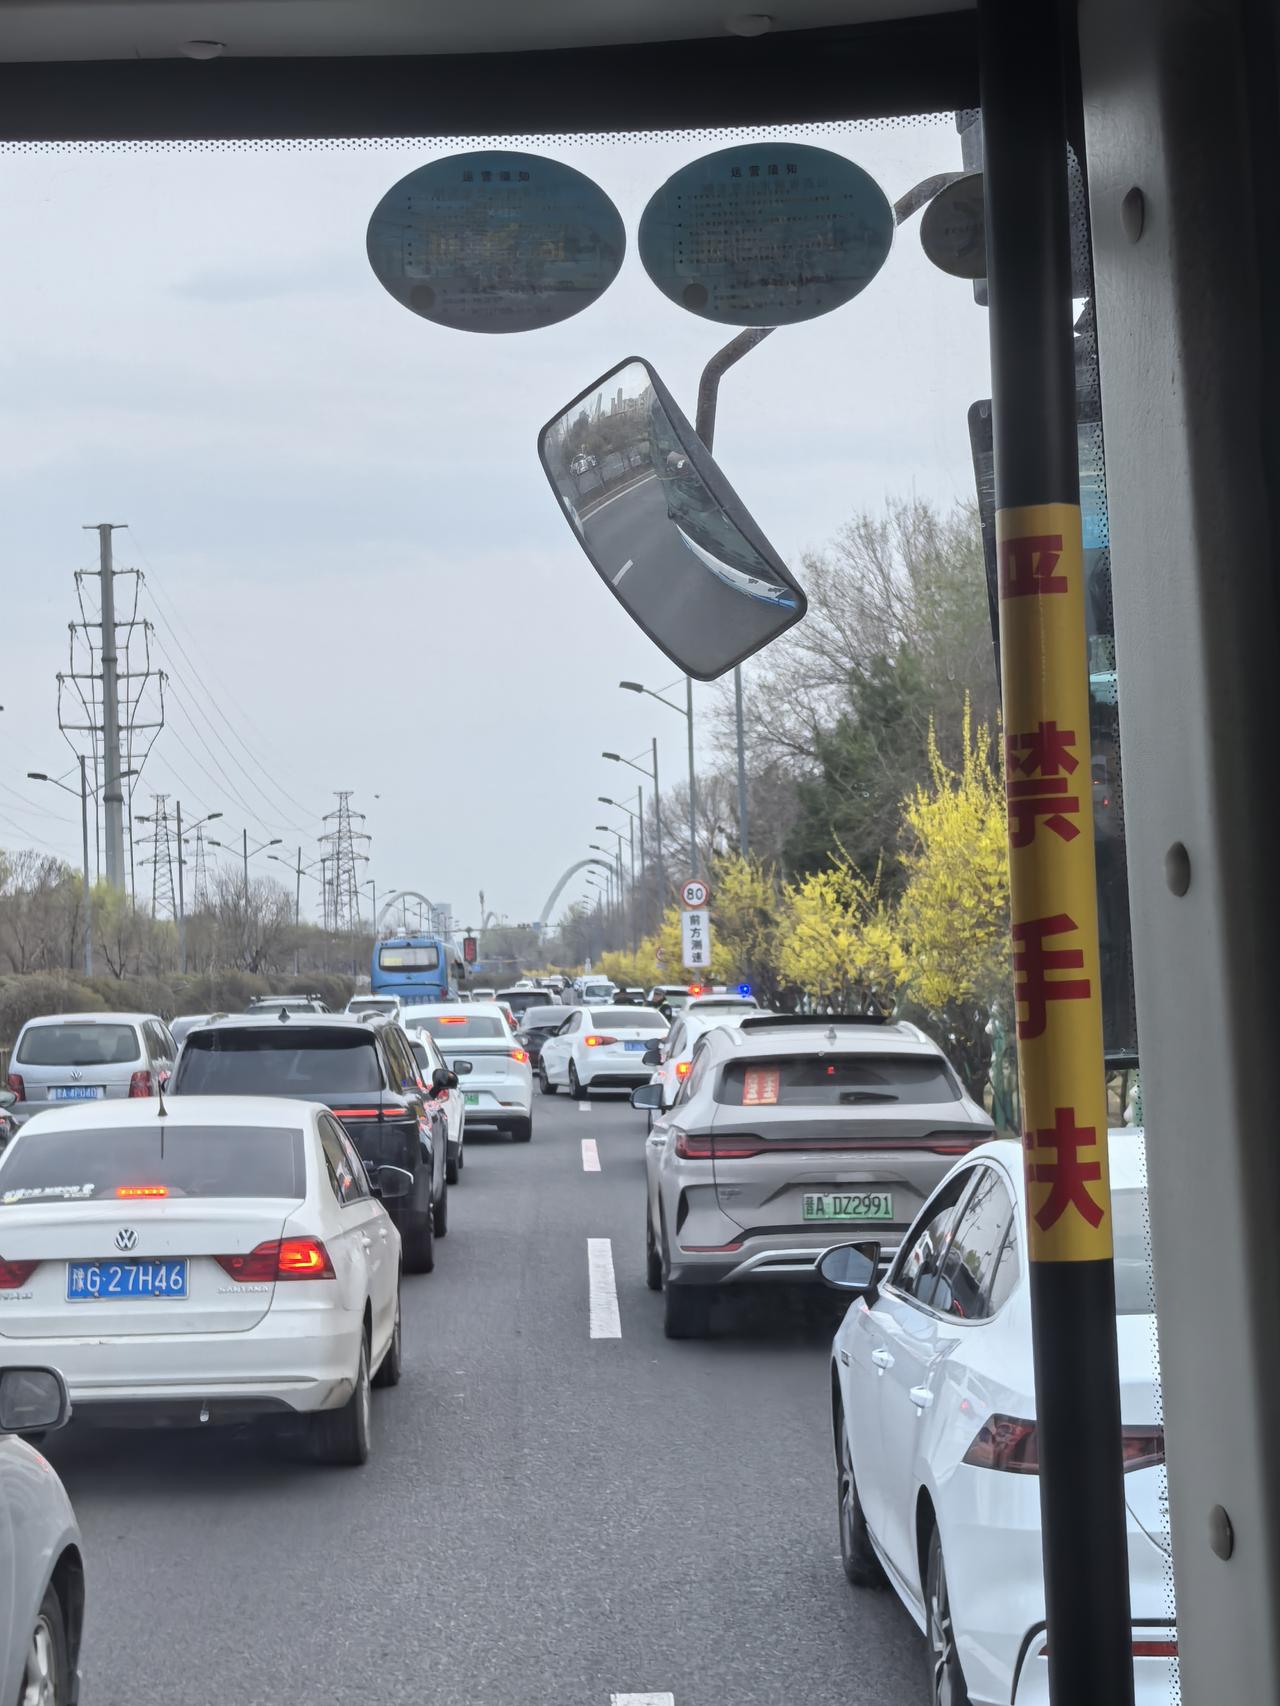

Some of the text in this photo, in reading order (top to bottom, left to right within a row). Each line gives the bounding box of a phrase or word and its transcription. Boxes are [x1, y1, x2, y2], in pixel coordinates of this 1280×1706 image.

[686, 888, 704, 901] 80
[689, 914, 703, 963] 前方测速
